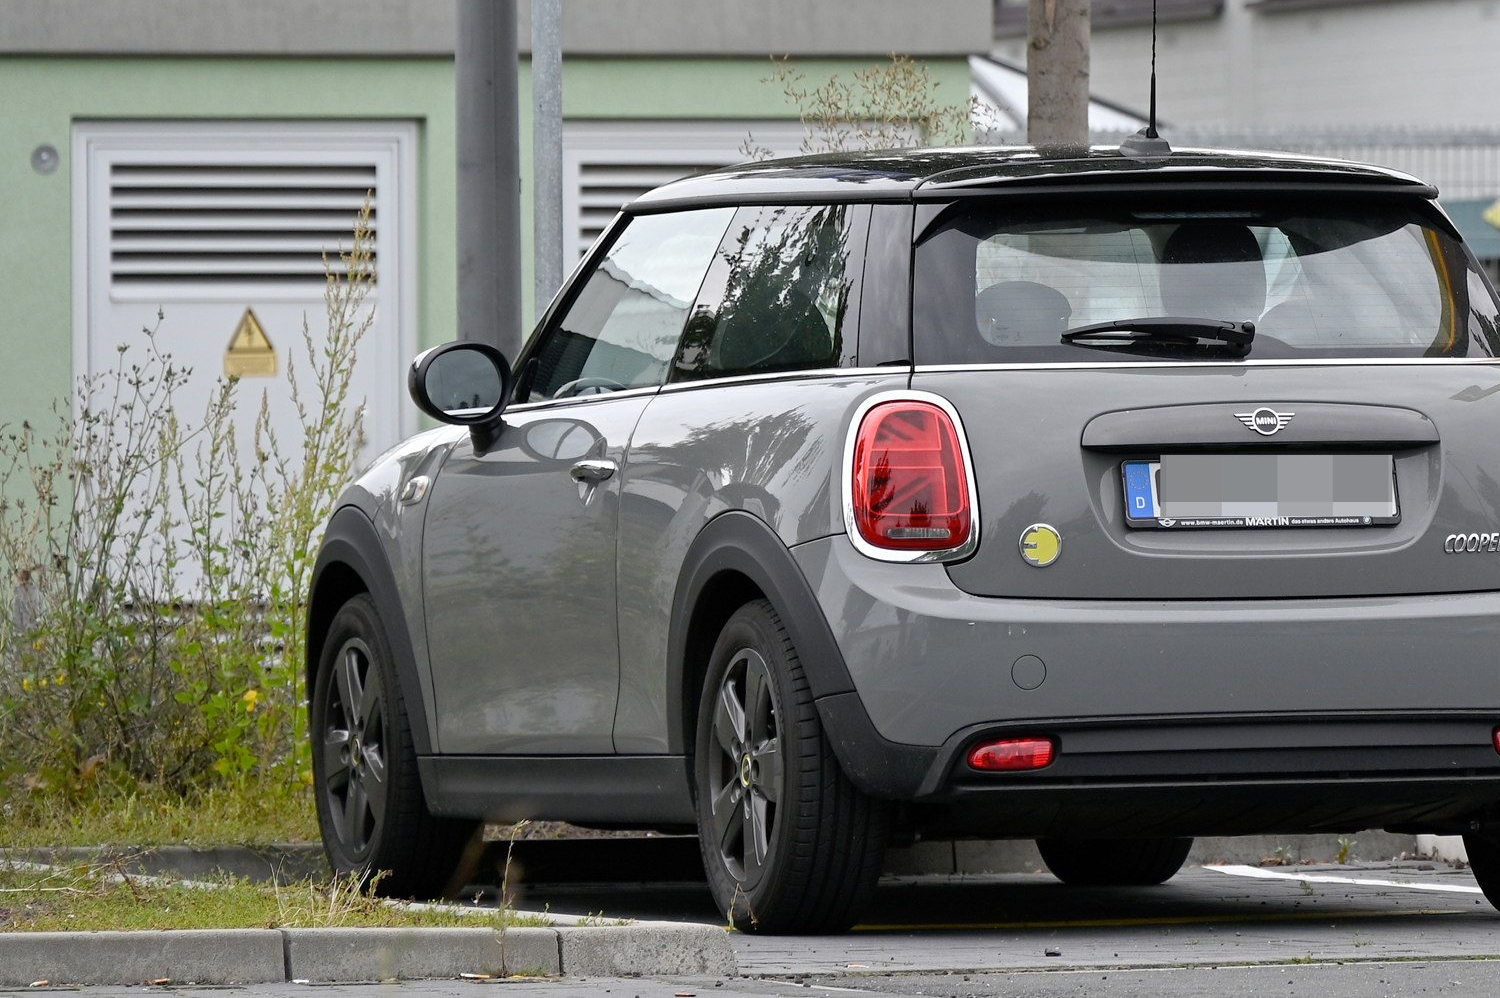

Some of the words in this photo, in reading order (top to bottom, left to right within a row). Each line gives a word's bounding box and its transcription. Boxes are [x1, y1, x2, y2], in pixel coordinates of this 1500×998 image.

[1255, 416, 1277, 425] MINI
[1135, 496, 1146, 509] D
[1180, 519, 1244, 527] www.bmw-maertin.de
